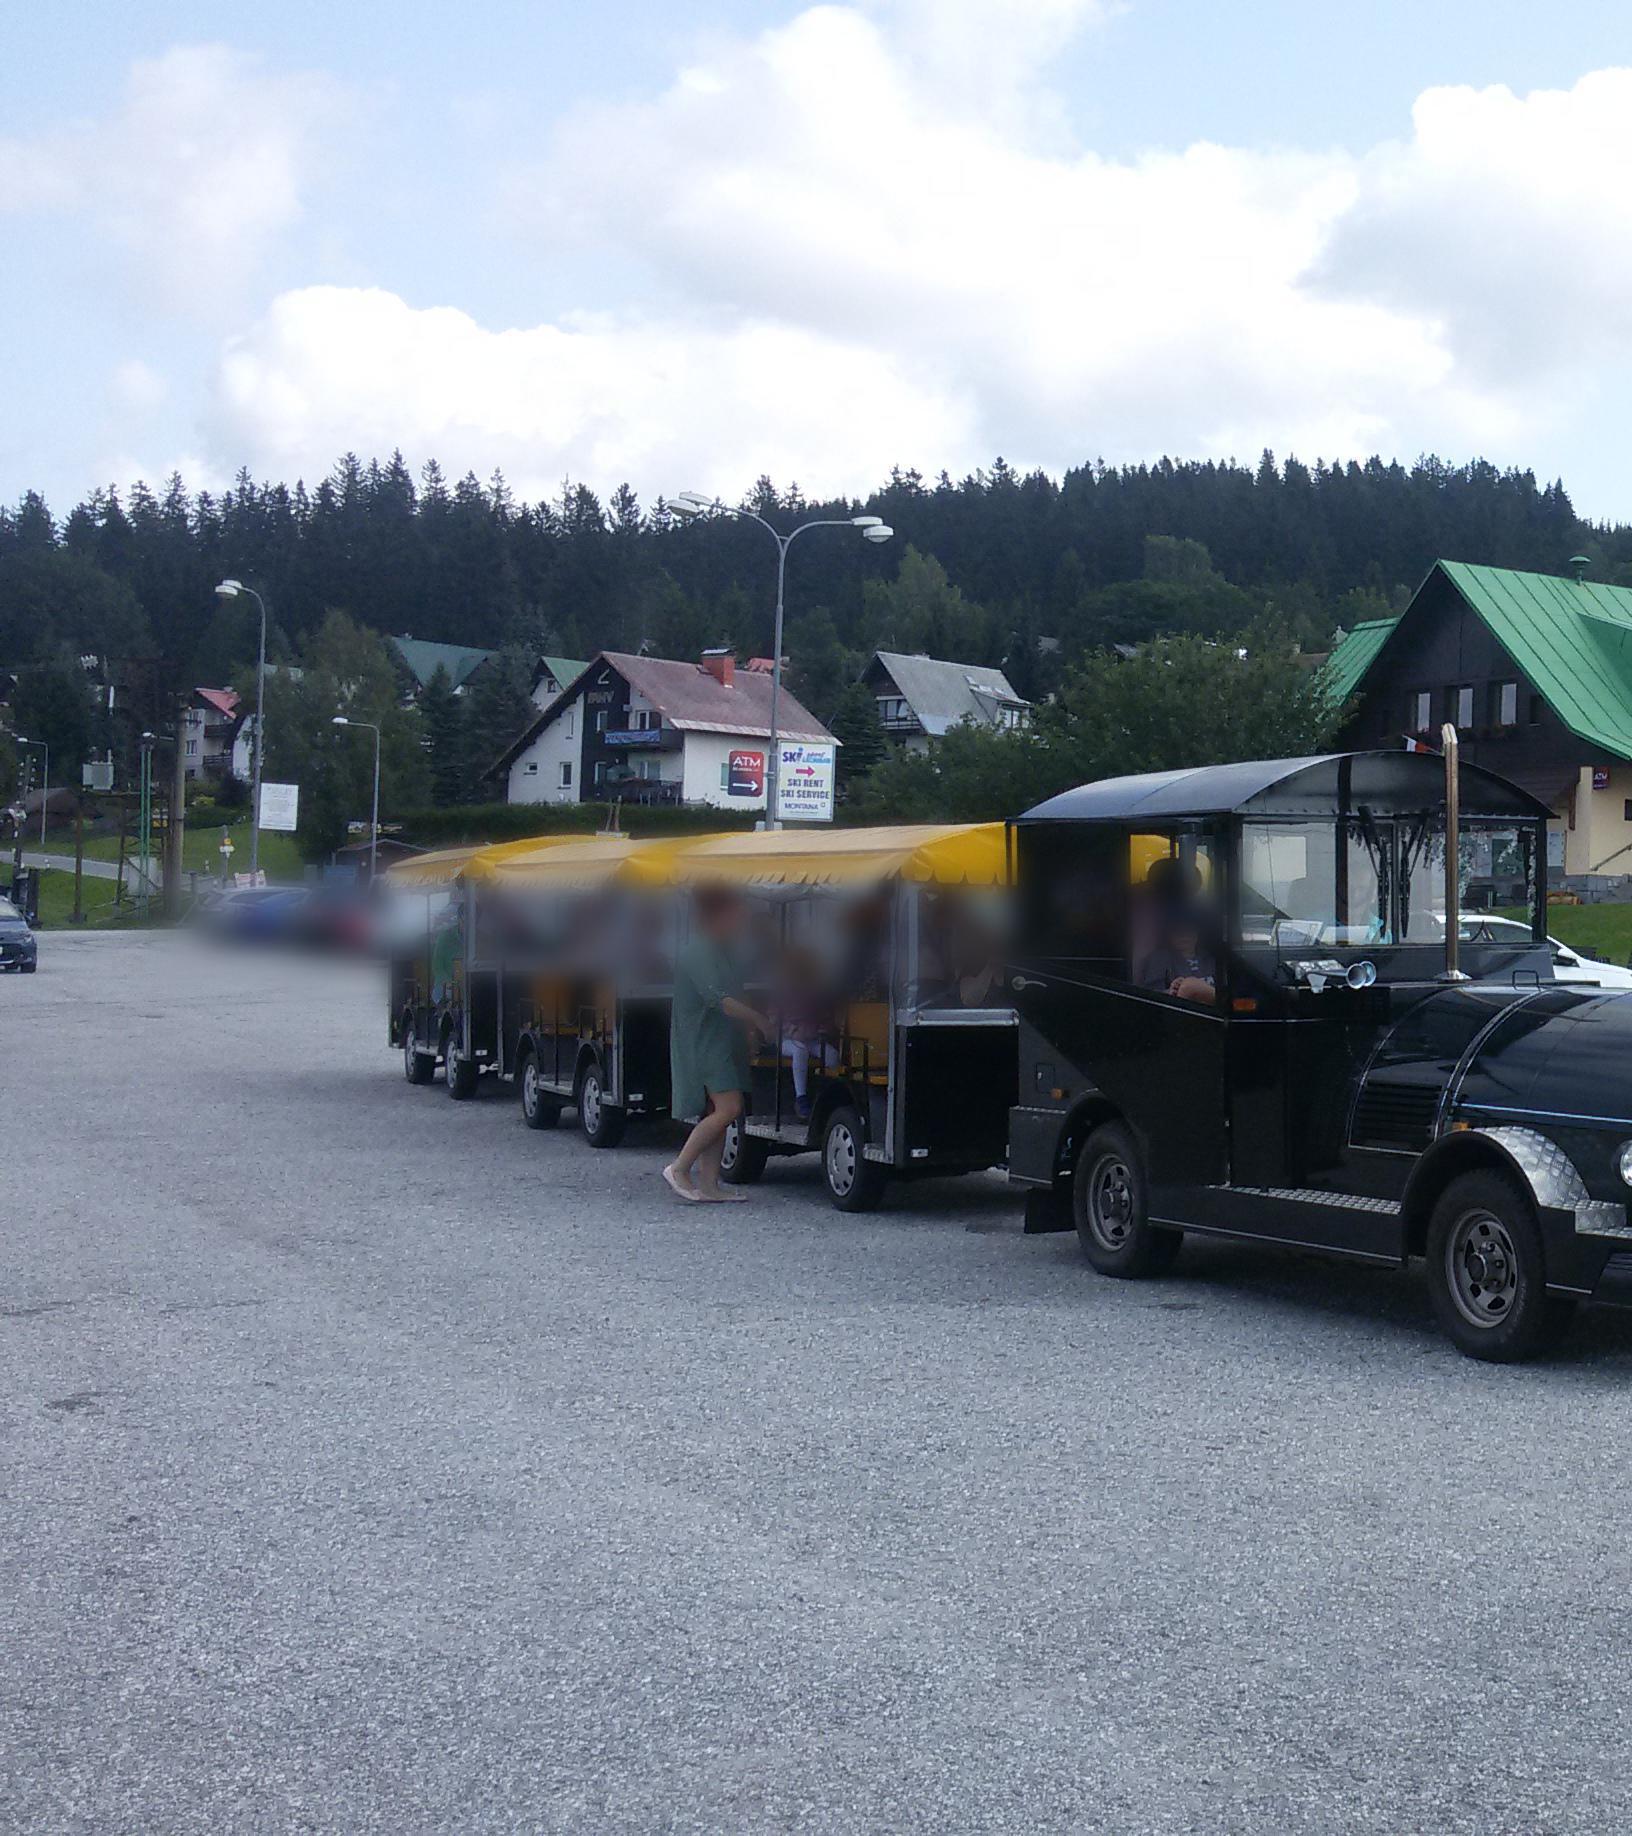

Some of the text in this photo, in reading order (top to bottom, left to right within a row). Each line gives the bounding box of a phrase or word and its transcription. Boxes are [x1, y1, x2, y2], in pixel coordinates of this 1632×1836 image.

[733, 756, 761, 767] ATM
[787, 779, 824, 788] SKI RENT
[781, 790, 830, 799] SKI SERVICE
